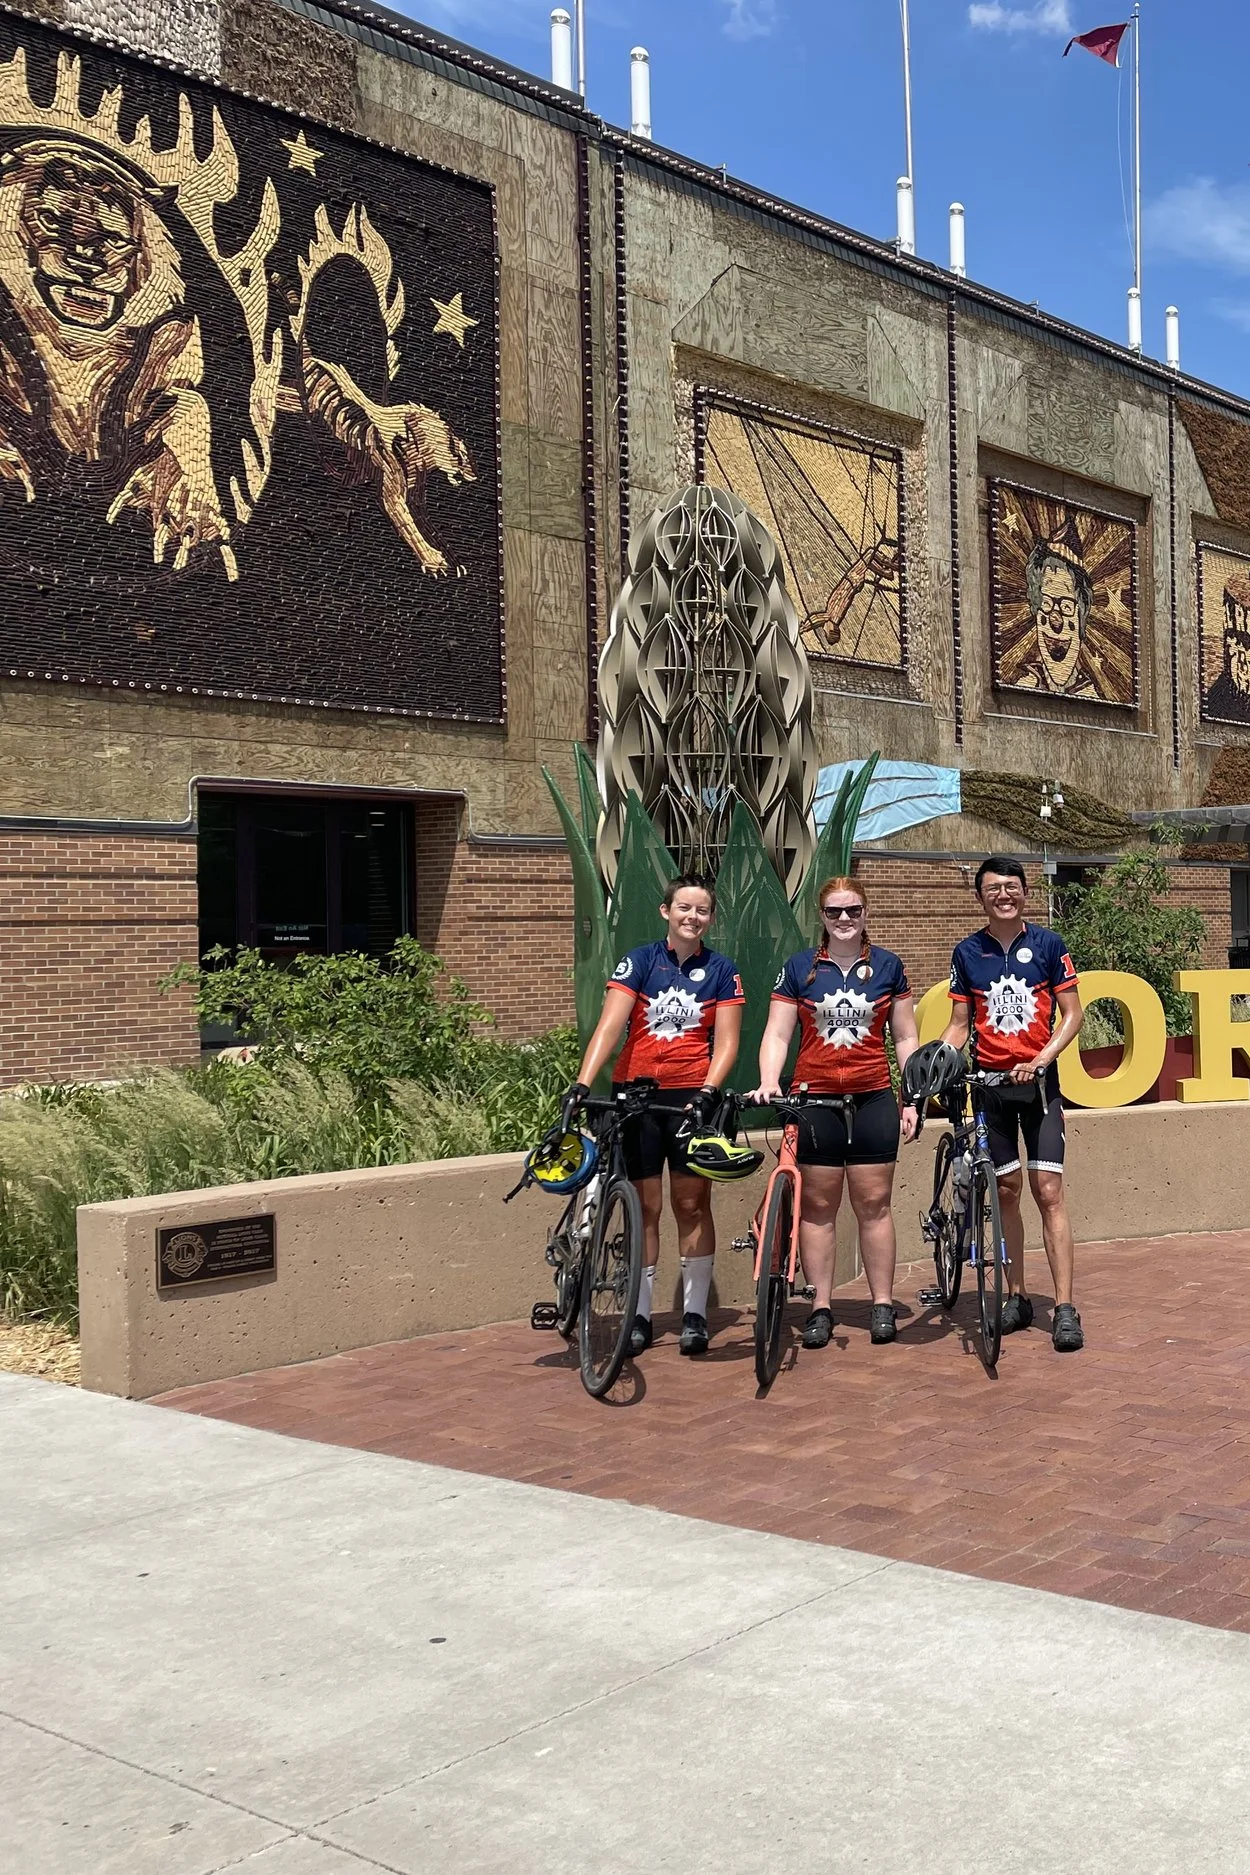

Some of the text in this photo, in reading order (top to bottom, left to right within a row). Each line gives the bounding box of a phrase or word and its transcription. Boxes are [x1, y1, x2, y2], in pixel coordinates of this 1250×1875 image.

[993, 995, 1028, 1006] ILLINI
[655, 1006, 694, 1017] ILLINI
[823, 1009, 867, 1018] ILLINI
[995, 1005, 1023, 1014] 4000
[827, 1019, 859, 1027] 4000
